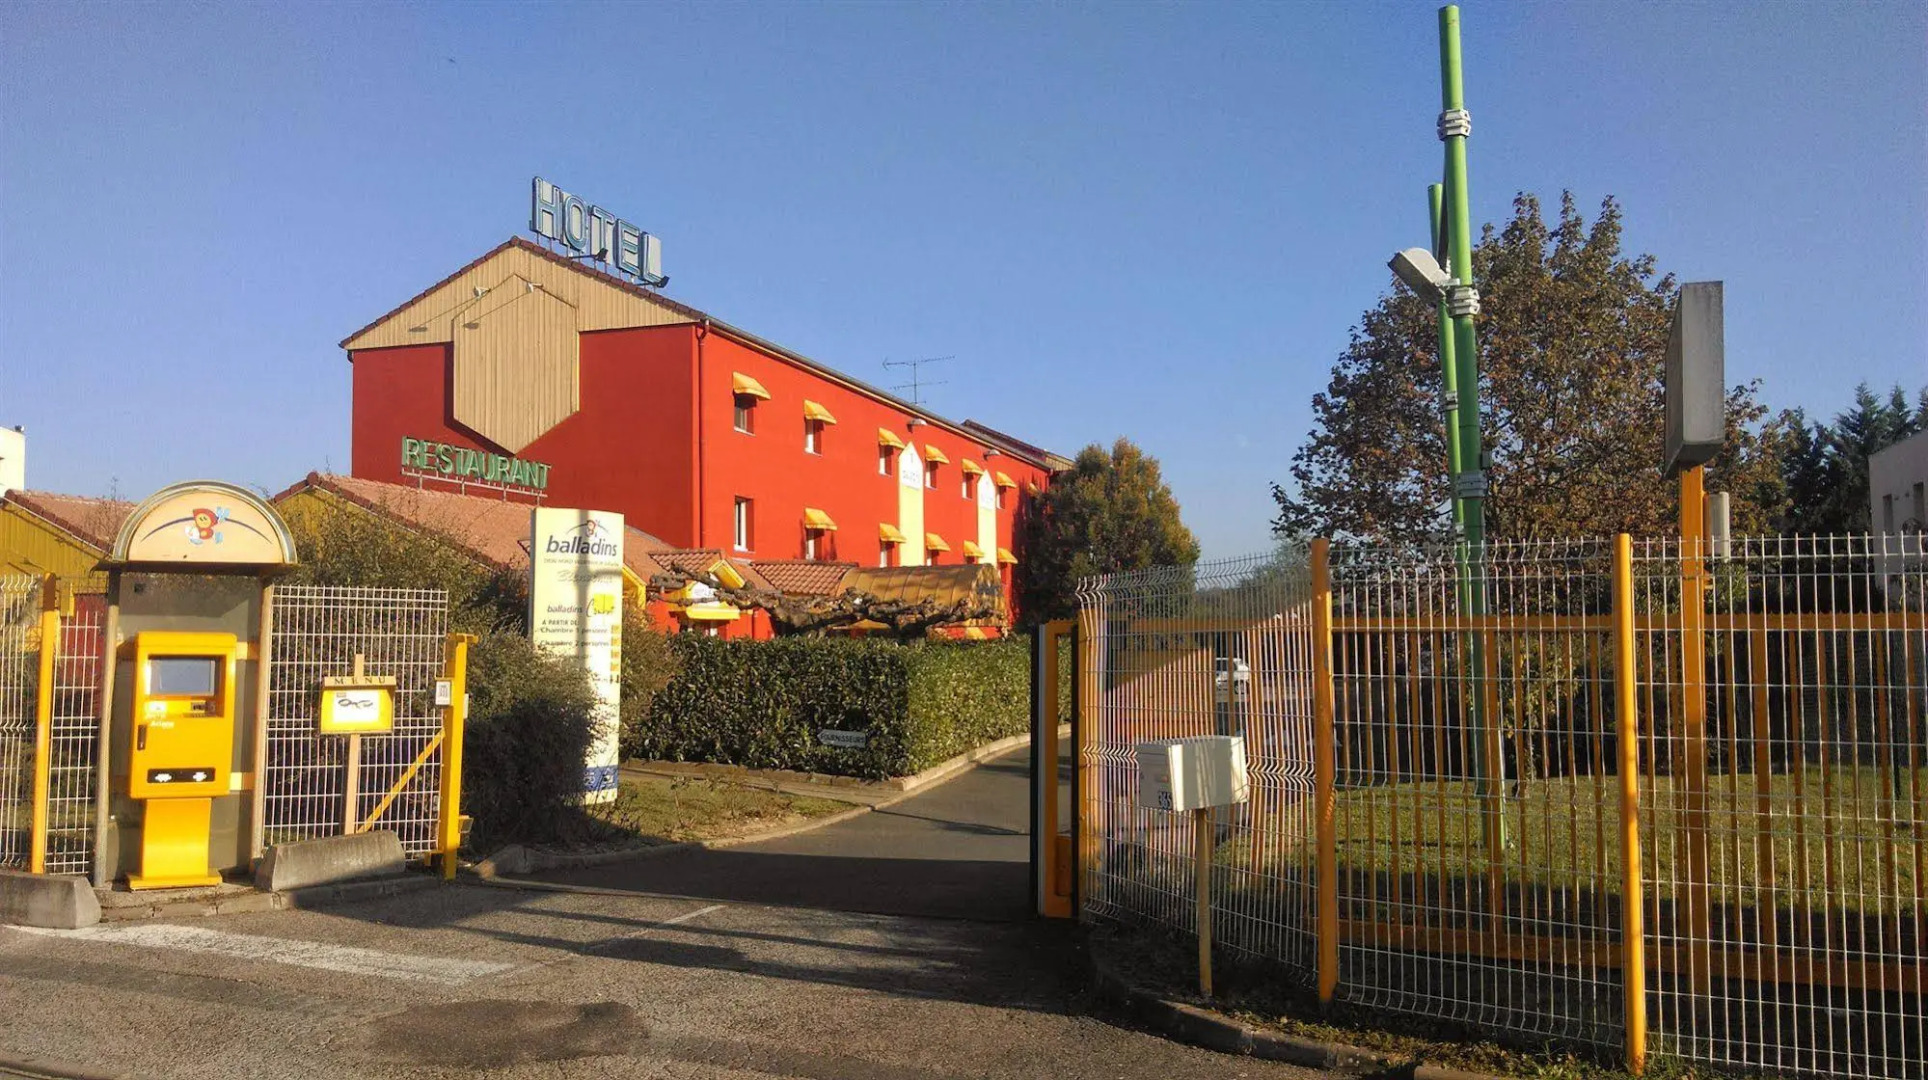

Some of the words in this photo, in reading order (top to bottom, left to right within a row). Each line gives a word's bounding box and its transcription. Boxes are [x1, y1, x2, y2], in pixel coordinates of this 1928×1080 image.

[532, 176, 661, 283] HOTEL
[402, 437, 552, 489] RESTAURANT
[546, 535, 618, 557] balladins
[547, 604, 583, 613] balladins
[334, 676, 386, 685] MENU
[820, 732, 866, 743] FOURNISSEURS
